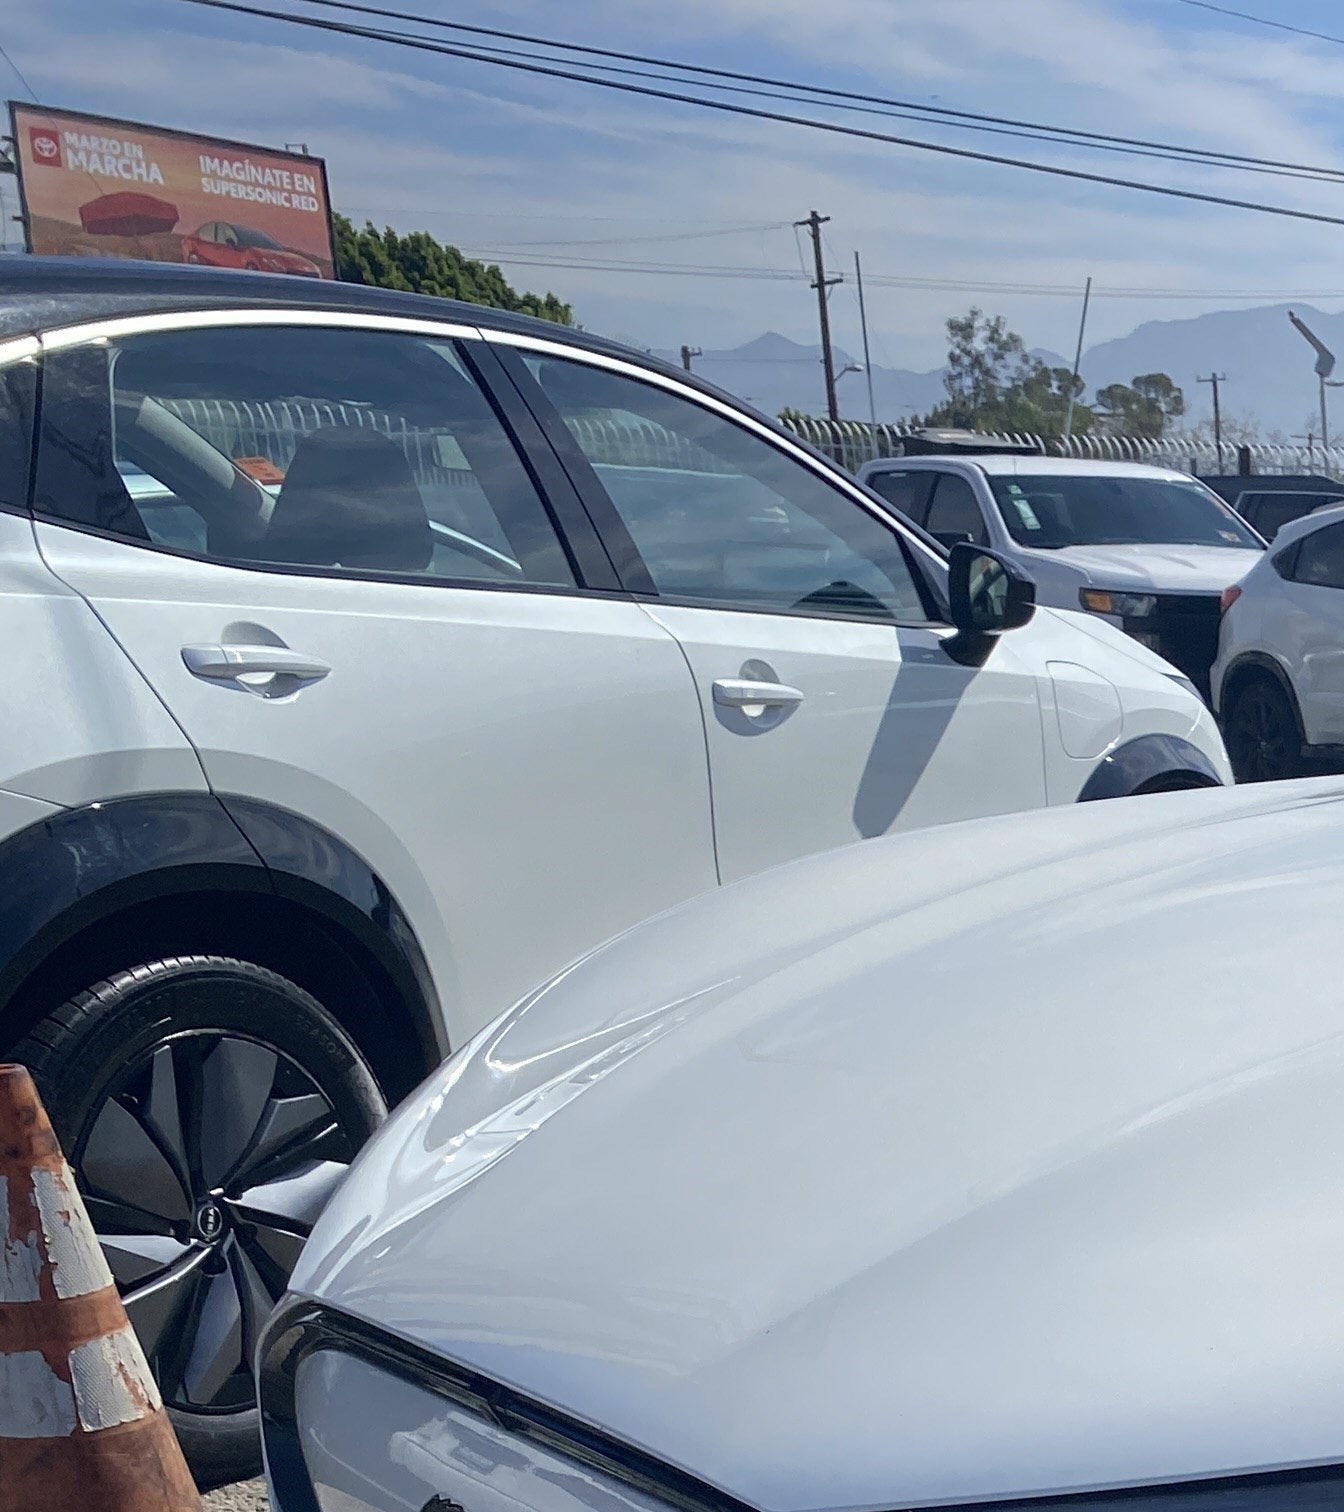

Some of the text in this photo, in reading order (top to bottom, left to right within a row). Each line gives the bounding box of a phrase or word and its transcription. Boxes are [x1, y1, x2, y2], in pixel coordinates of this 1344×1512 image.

[64, 131, 144, 158] MARZO EN
[66, 149, 164, 185] MARCHA
[199, 154, 315, 194] IMAGÍNATE EN
[202, 180, 319, 212] SUPERSONIC RED
